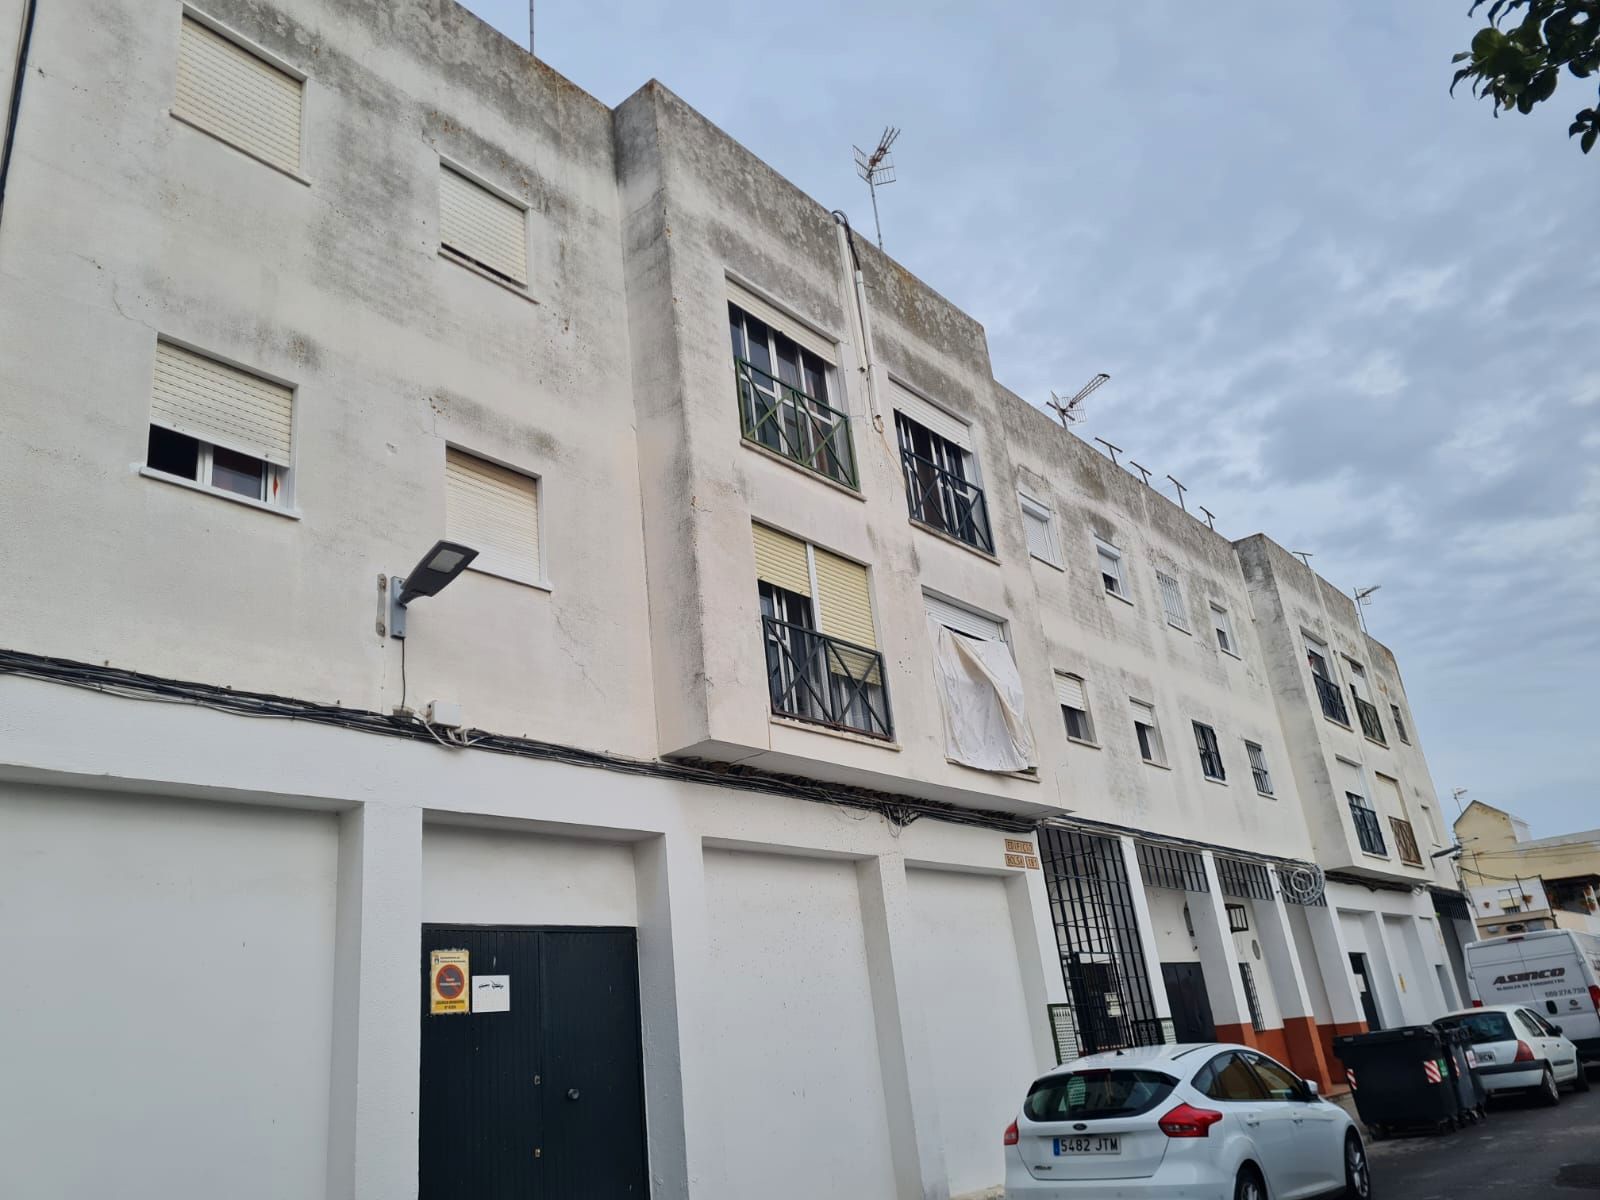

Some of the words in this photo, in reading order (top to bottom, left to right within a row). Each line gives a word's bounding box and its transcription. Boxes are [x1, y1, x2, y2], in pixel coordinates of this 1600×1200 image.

[1007, 841, 1033, 854] EDIFICIO
[1061, 1138, 1090, 1152] 5482
[1095, 1138, 1118, 1151] JTM
